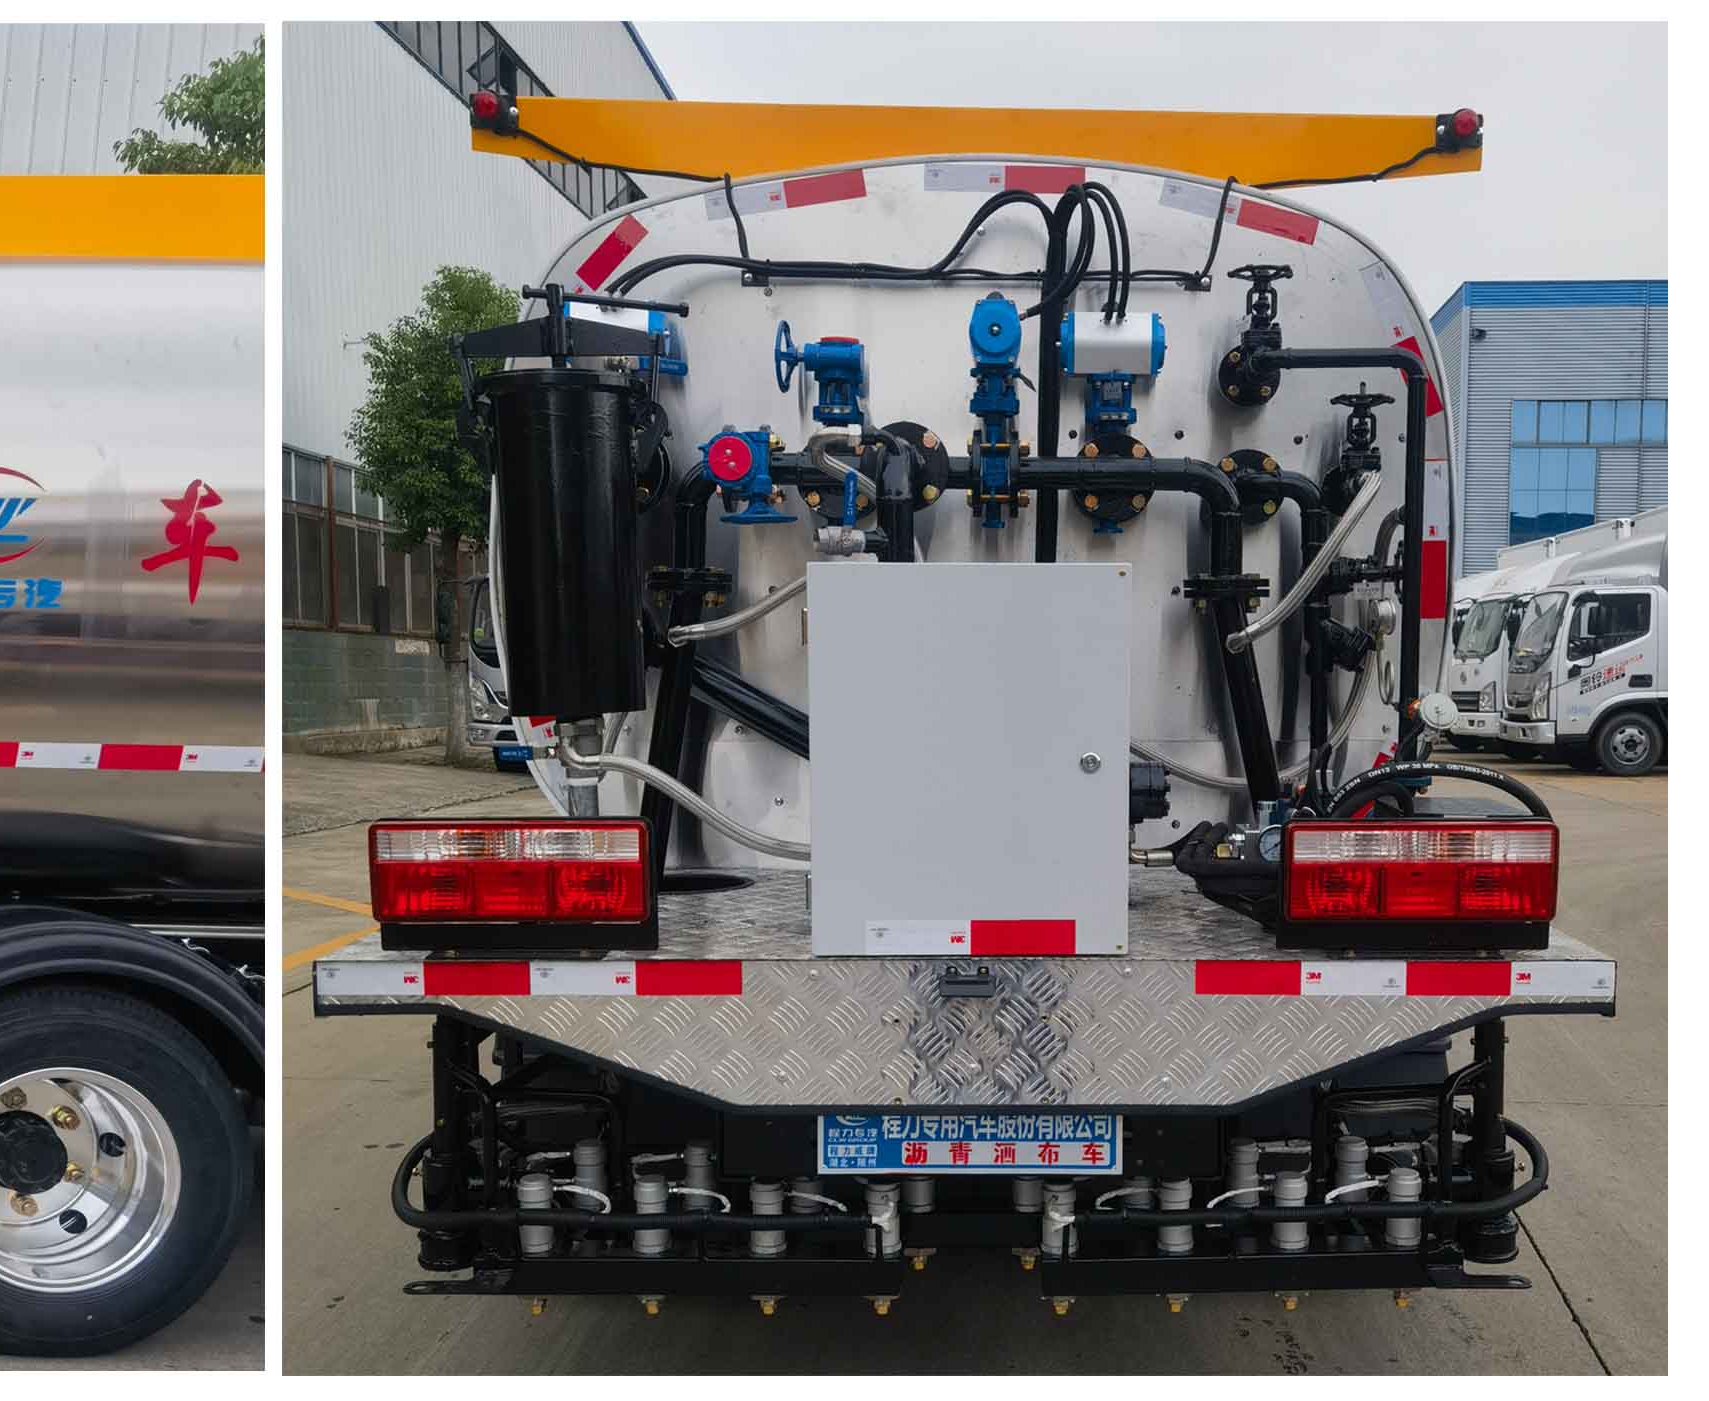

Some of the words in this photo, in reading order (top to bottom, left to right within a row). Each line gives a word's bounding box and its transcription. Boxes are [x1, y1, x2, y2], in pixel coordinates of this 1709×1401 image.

[141, 478, 239, 607] 车
[949, 936, 965, 945] 3M
[403, 975, 420, 985] 3M
[615, 975, 631, 985] 3M
[1306, 971, 1322, 982] 3M
[1515, 972, 1532, 983] 3M
